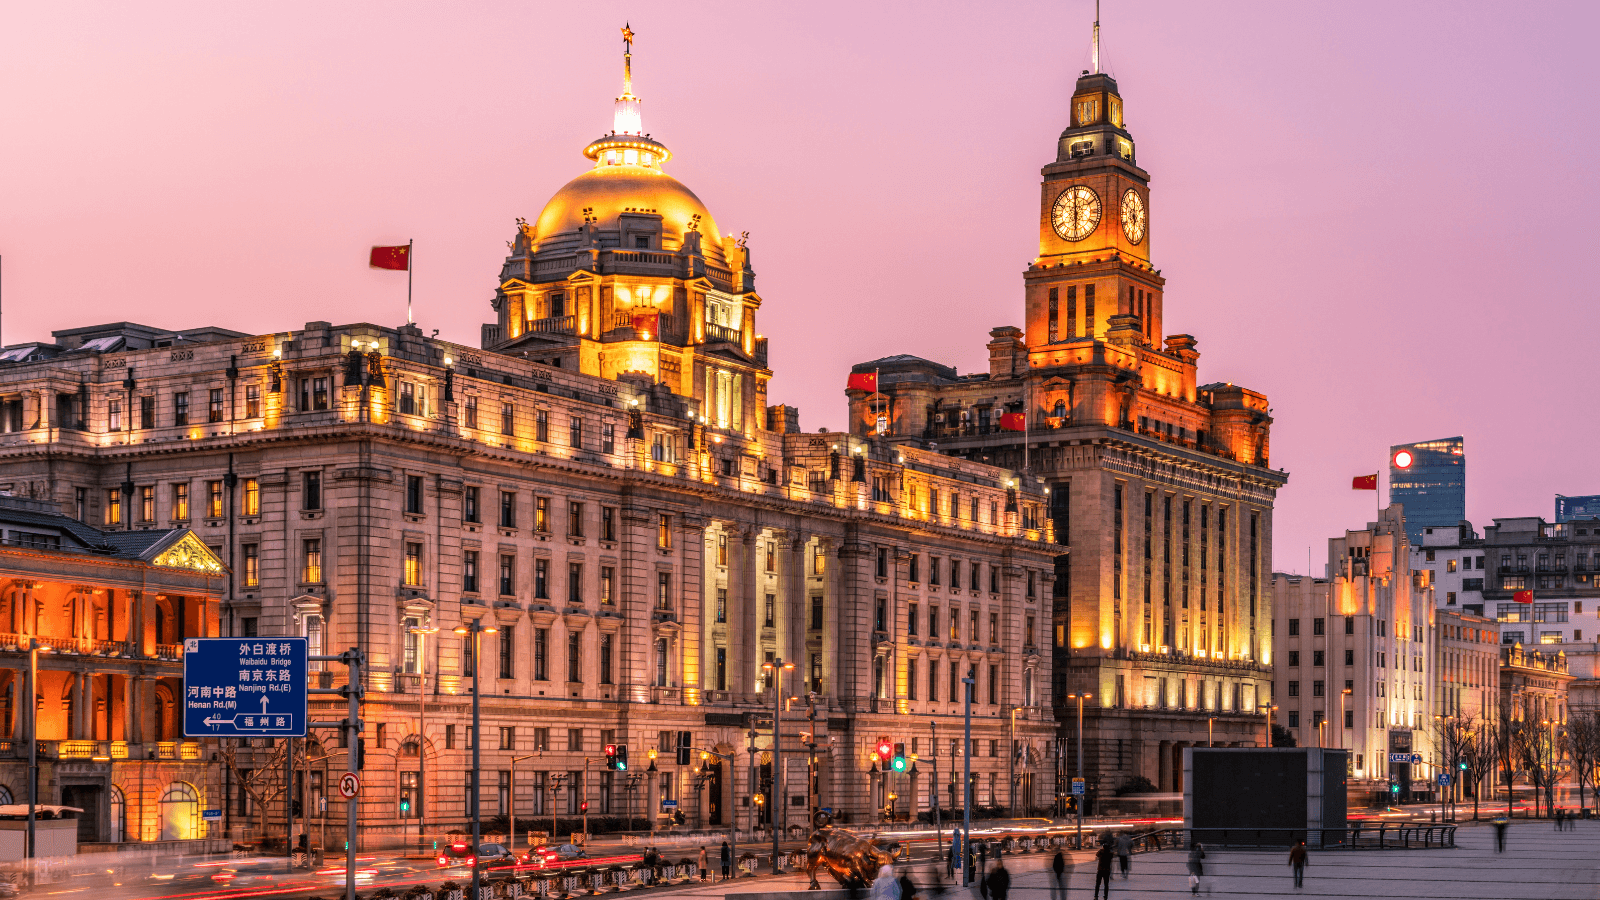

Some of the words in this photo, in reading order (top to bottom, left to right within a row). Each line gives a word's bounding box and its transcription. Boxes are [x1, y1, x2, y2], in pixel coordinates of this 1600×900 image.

[239, 643, 291, 655] 外白渡桥
[271, 658, 291, 667] Bridge
[239, 669, 291, 681] 南京东路
[188, 686, 236, 698] 河南中路
[239, 684, 266, 693] Nanjing
[269, 684, 291, 693] Rd.(E)
[213, 701, 237, 710] Rd.(M)
[244, 717, 285, 726] 福州路
